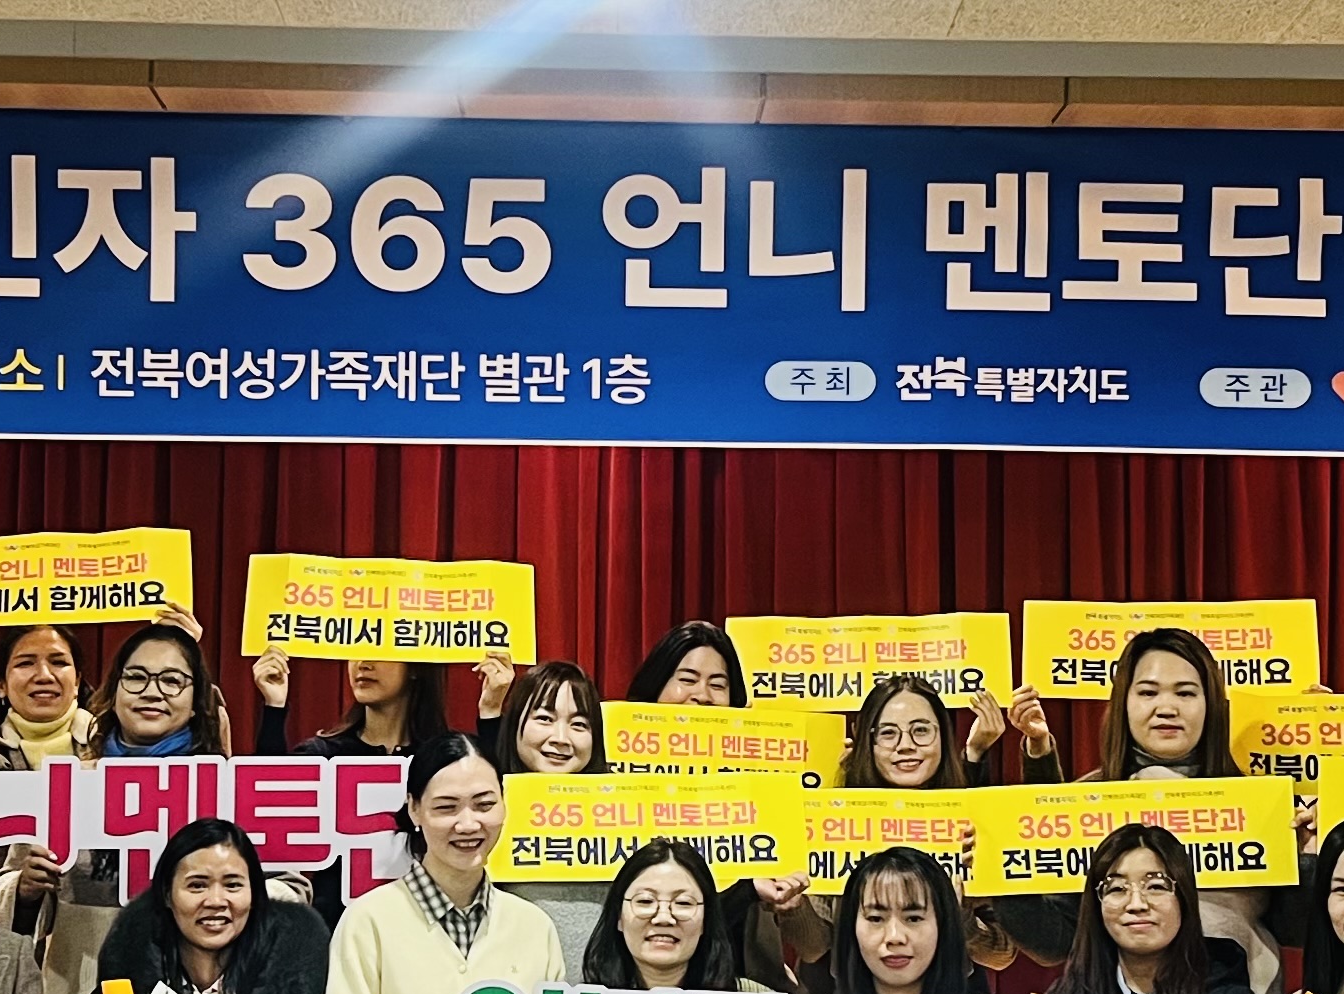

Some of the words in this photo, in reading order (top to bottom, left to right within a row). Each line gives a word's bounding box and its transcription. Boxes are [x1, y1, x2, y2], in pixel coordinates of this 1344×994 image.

[243, 173, 551, 293] 365
[603, 168, 866, 311] 언니
[926, 172, 1342, 317] 멘토단
[91, 348, 465, 401] 전북여성가족재단
[480, 353, 569, 402] 별관
[583, 354, 650, 404] 1층
[790, 366, 853, 397] 주최
[896, 357, 971, 400] 전북
[974, 366, 1129, 403] 특별자치도
[1224, 373, 1287, 405] 주관
[0, 560, 43, 580] 언니
[54, 554, 148, 578] 멘토단과
[49, 581, 165, 610] 함께해요
[284, 583, 332, 605] 365
[343, 587, 387, 608] 언니
[400, 588, 493, 611] 멘토단과
[267, 614, 381, 645] 전북에서
[394, 619, 509, 647] 함께해요
[1070, 629, 1115, 650] 365
[1199, 629, 1273, 651] 토단과
[770, 644, 814, 663] 365
[824, 641, 865, 663] 언니
[876, 641, 966, 662] 멘토단과
[752, 672, 861, 698] 전북에서
[617, 731, 659, 754] 365
[669, 734, 712, 758] 언니
[722, 736, 808, 763] 멘토단과
[1261, 724, 1311, 746] 365
[530, 805, 582, 826] 365
[592, 802, 644, 825] 언니
[654, 800, 755, 825] 멘토단과
[1020, 815, 1071, 839] 365
[823, 820, 870, 840] 언니
[1003, 846, 1096, 879] 전북에
